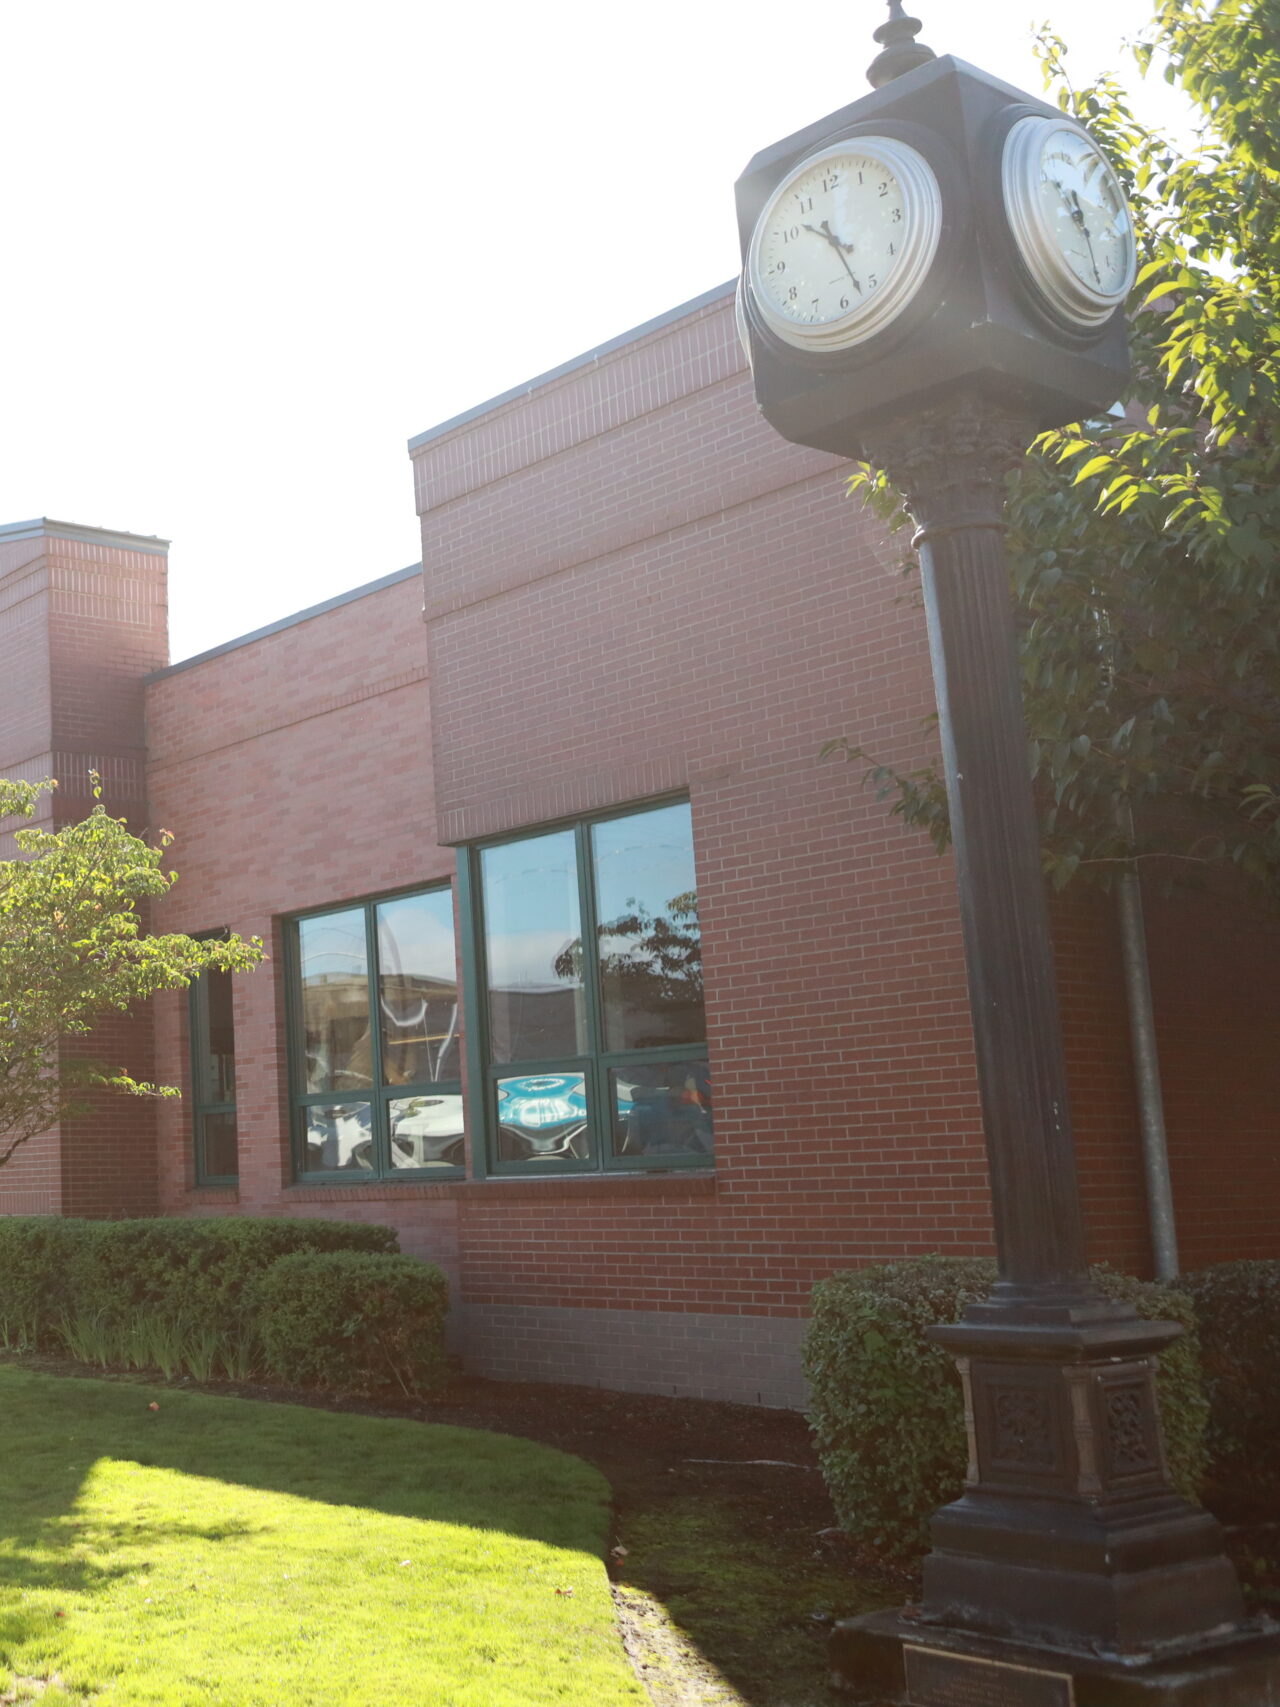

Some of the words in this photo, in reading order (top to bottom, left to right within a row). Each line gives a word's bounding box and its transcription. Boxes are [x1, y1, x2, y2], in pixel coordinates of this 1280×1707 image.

[822, 174, 839, 193] 12
[856, 171, 864, 186] 1
[878, 182, 889, 198] 2
[799, 197, 814, 215] 11
[891, 208, 902, 224] 3
[782, 226, 799, 244] 10
[887, 242, 897, 257] 4
[776, 261, 786, 275] 9
[868, 274, 878, 289] 5
[788, 286, 798, 301] 8
[811, 298, 820, 313] 7
[839, 296, 849, 310] 6
